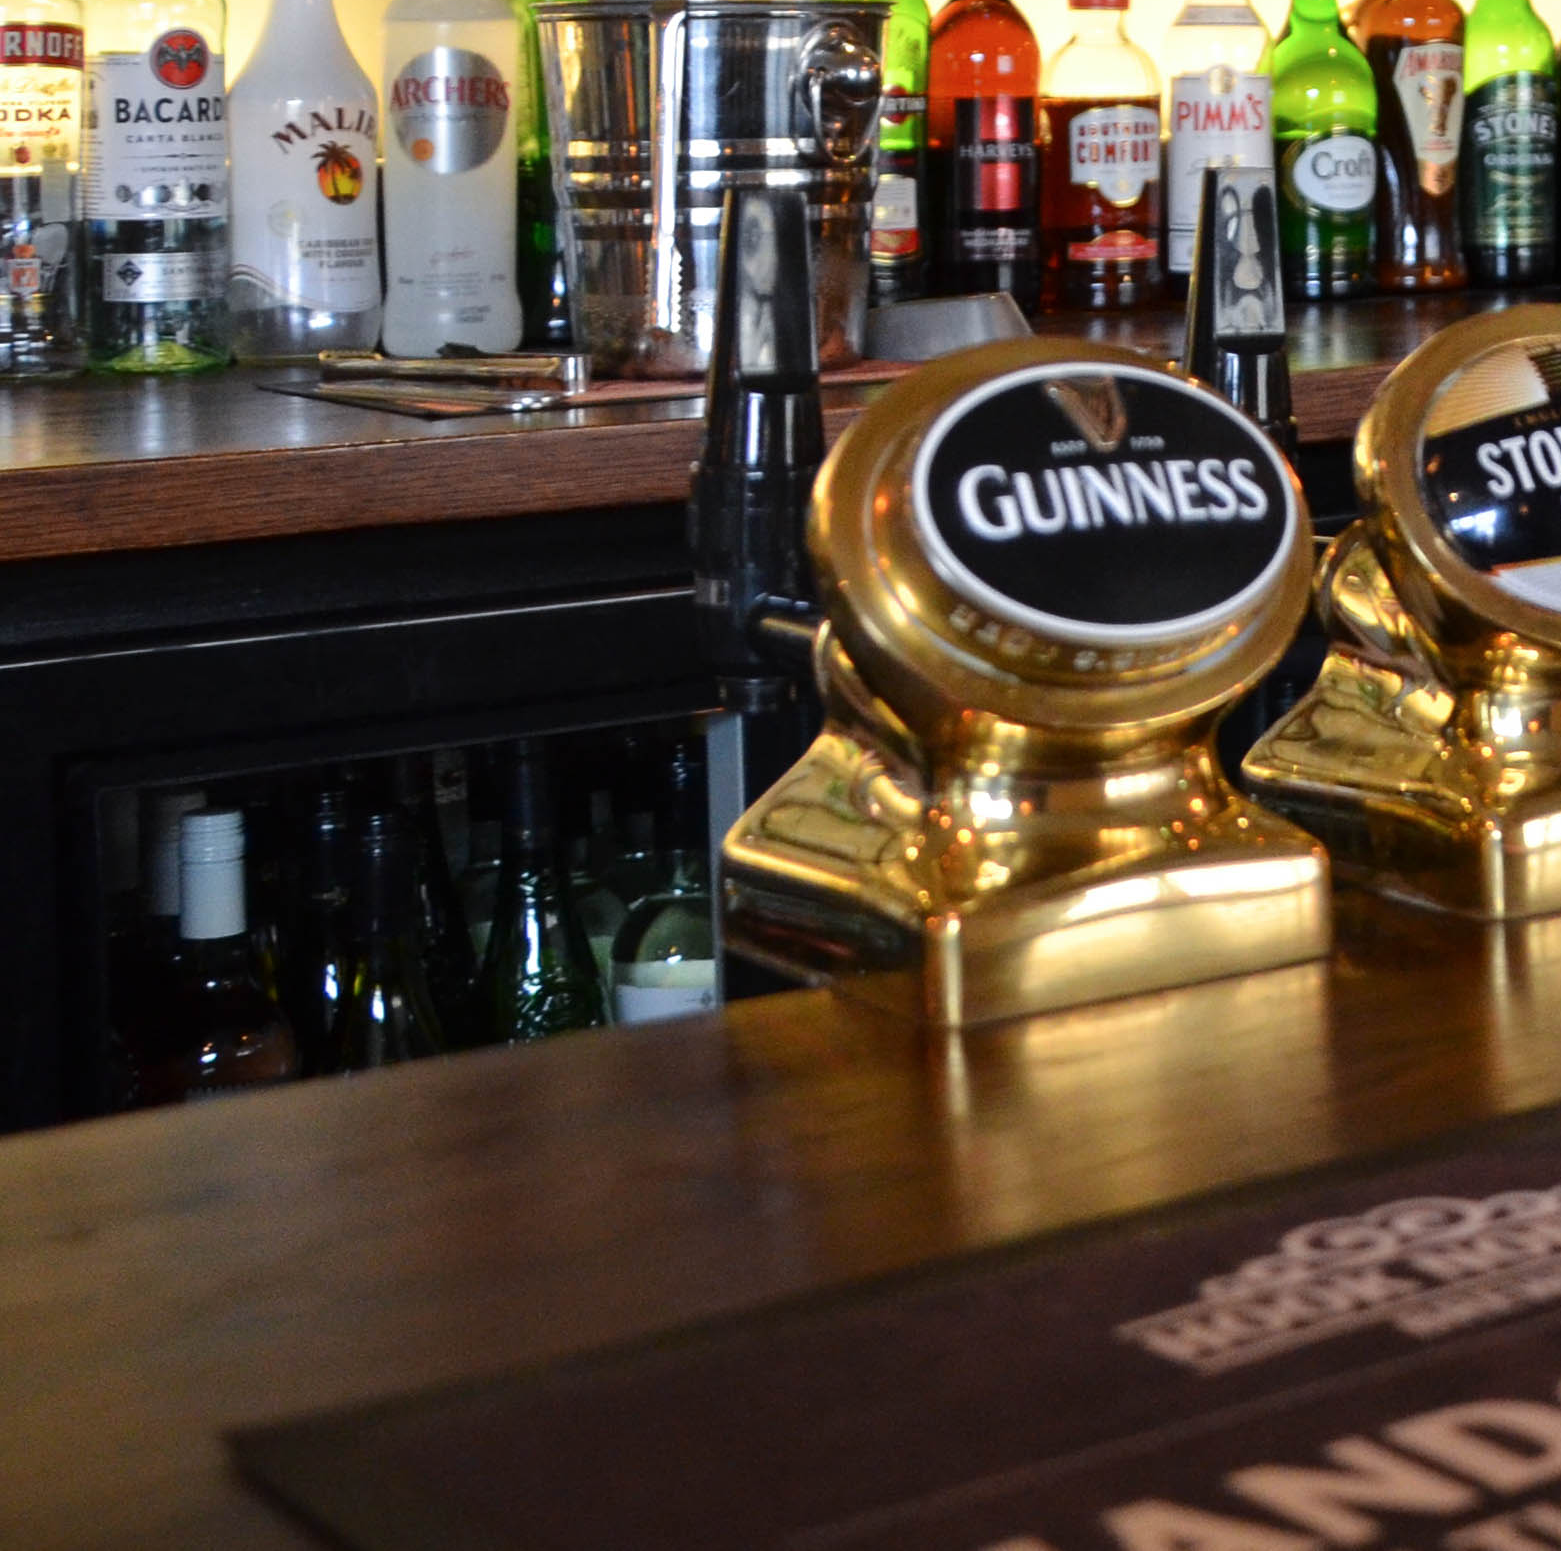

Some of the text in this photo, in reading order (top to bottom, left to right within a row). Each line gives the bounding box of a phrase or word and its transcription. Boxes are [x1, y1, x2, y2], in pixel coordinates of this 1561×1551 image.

[115, 96, 225, 124] BACARD
[390, 76, 511, 111] ARCHERS
[1176, 93, 1264, 131] PIMM'S
[1311, 149, 1372, 181] Croft
[956, 457, 1270, 542] GUINNESS
